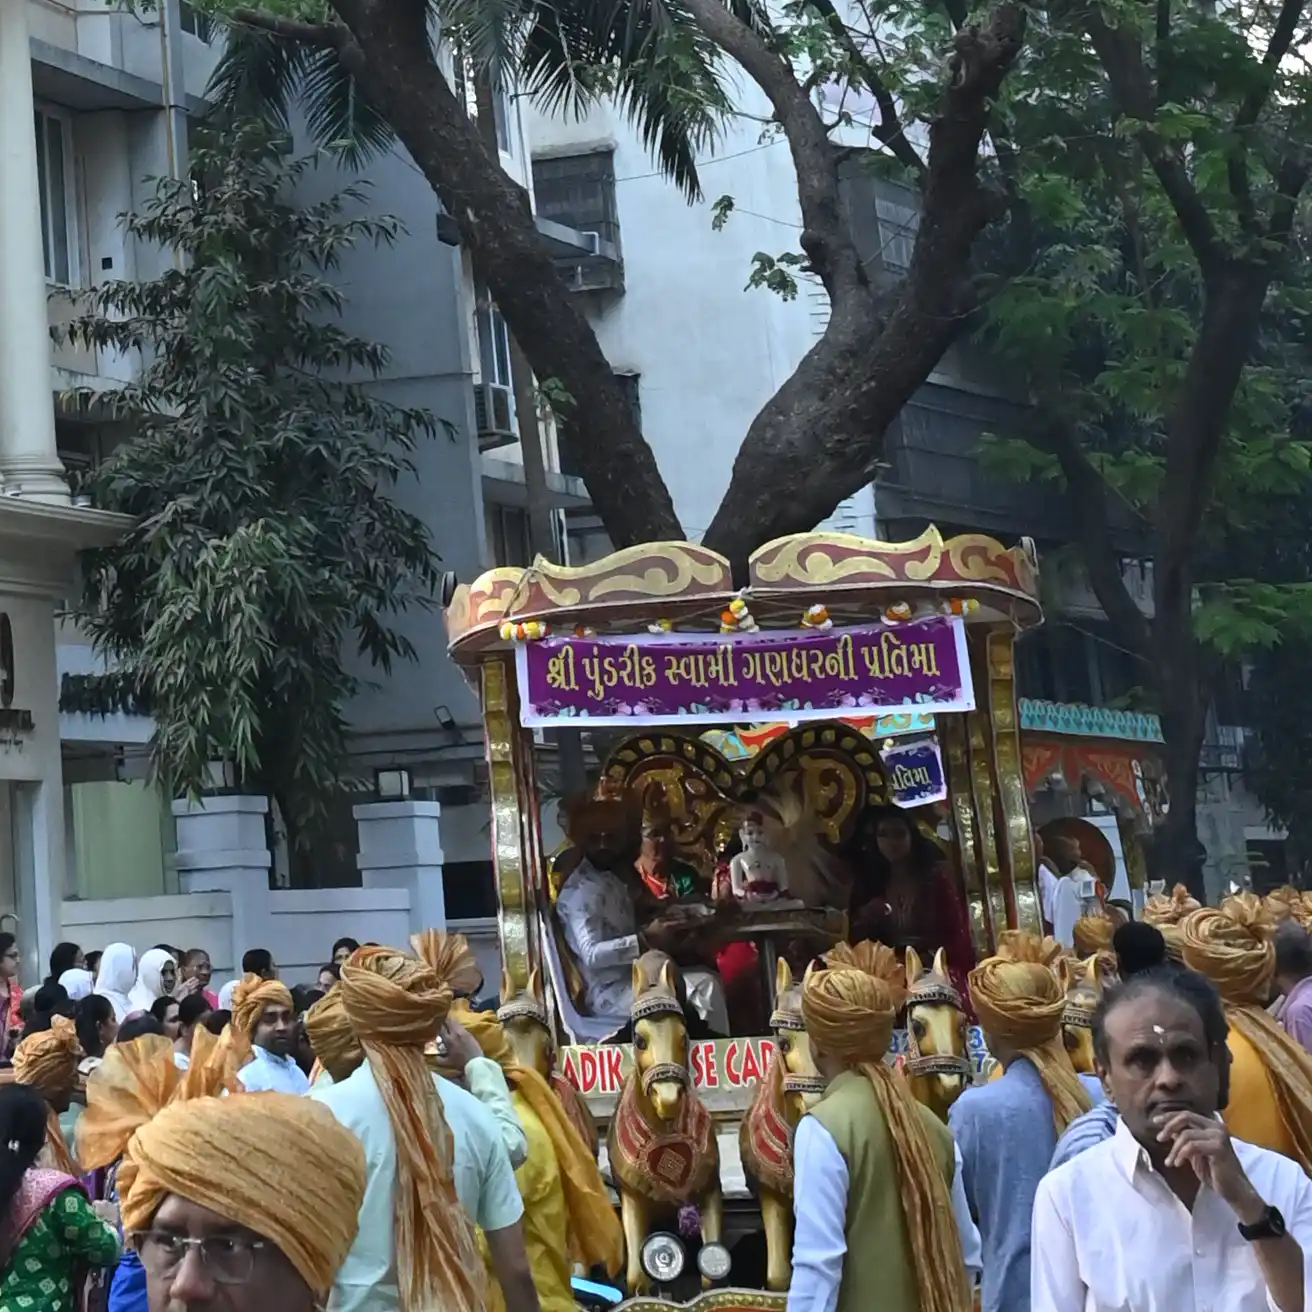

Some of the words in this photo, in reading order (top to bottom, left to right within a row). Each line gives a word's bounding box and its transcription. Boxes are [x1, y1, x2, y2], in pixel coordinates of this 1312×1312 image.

[546, 644, 580, 691] શ્રી
[582, 643, 657, 701] પુંડરીક
[664, 643, 738, 687] સ્વામી
[742, 634, 859, 687] ગણધરની
[861, 631, 941, 680] પ્રતિમા
